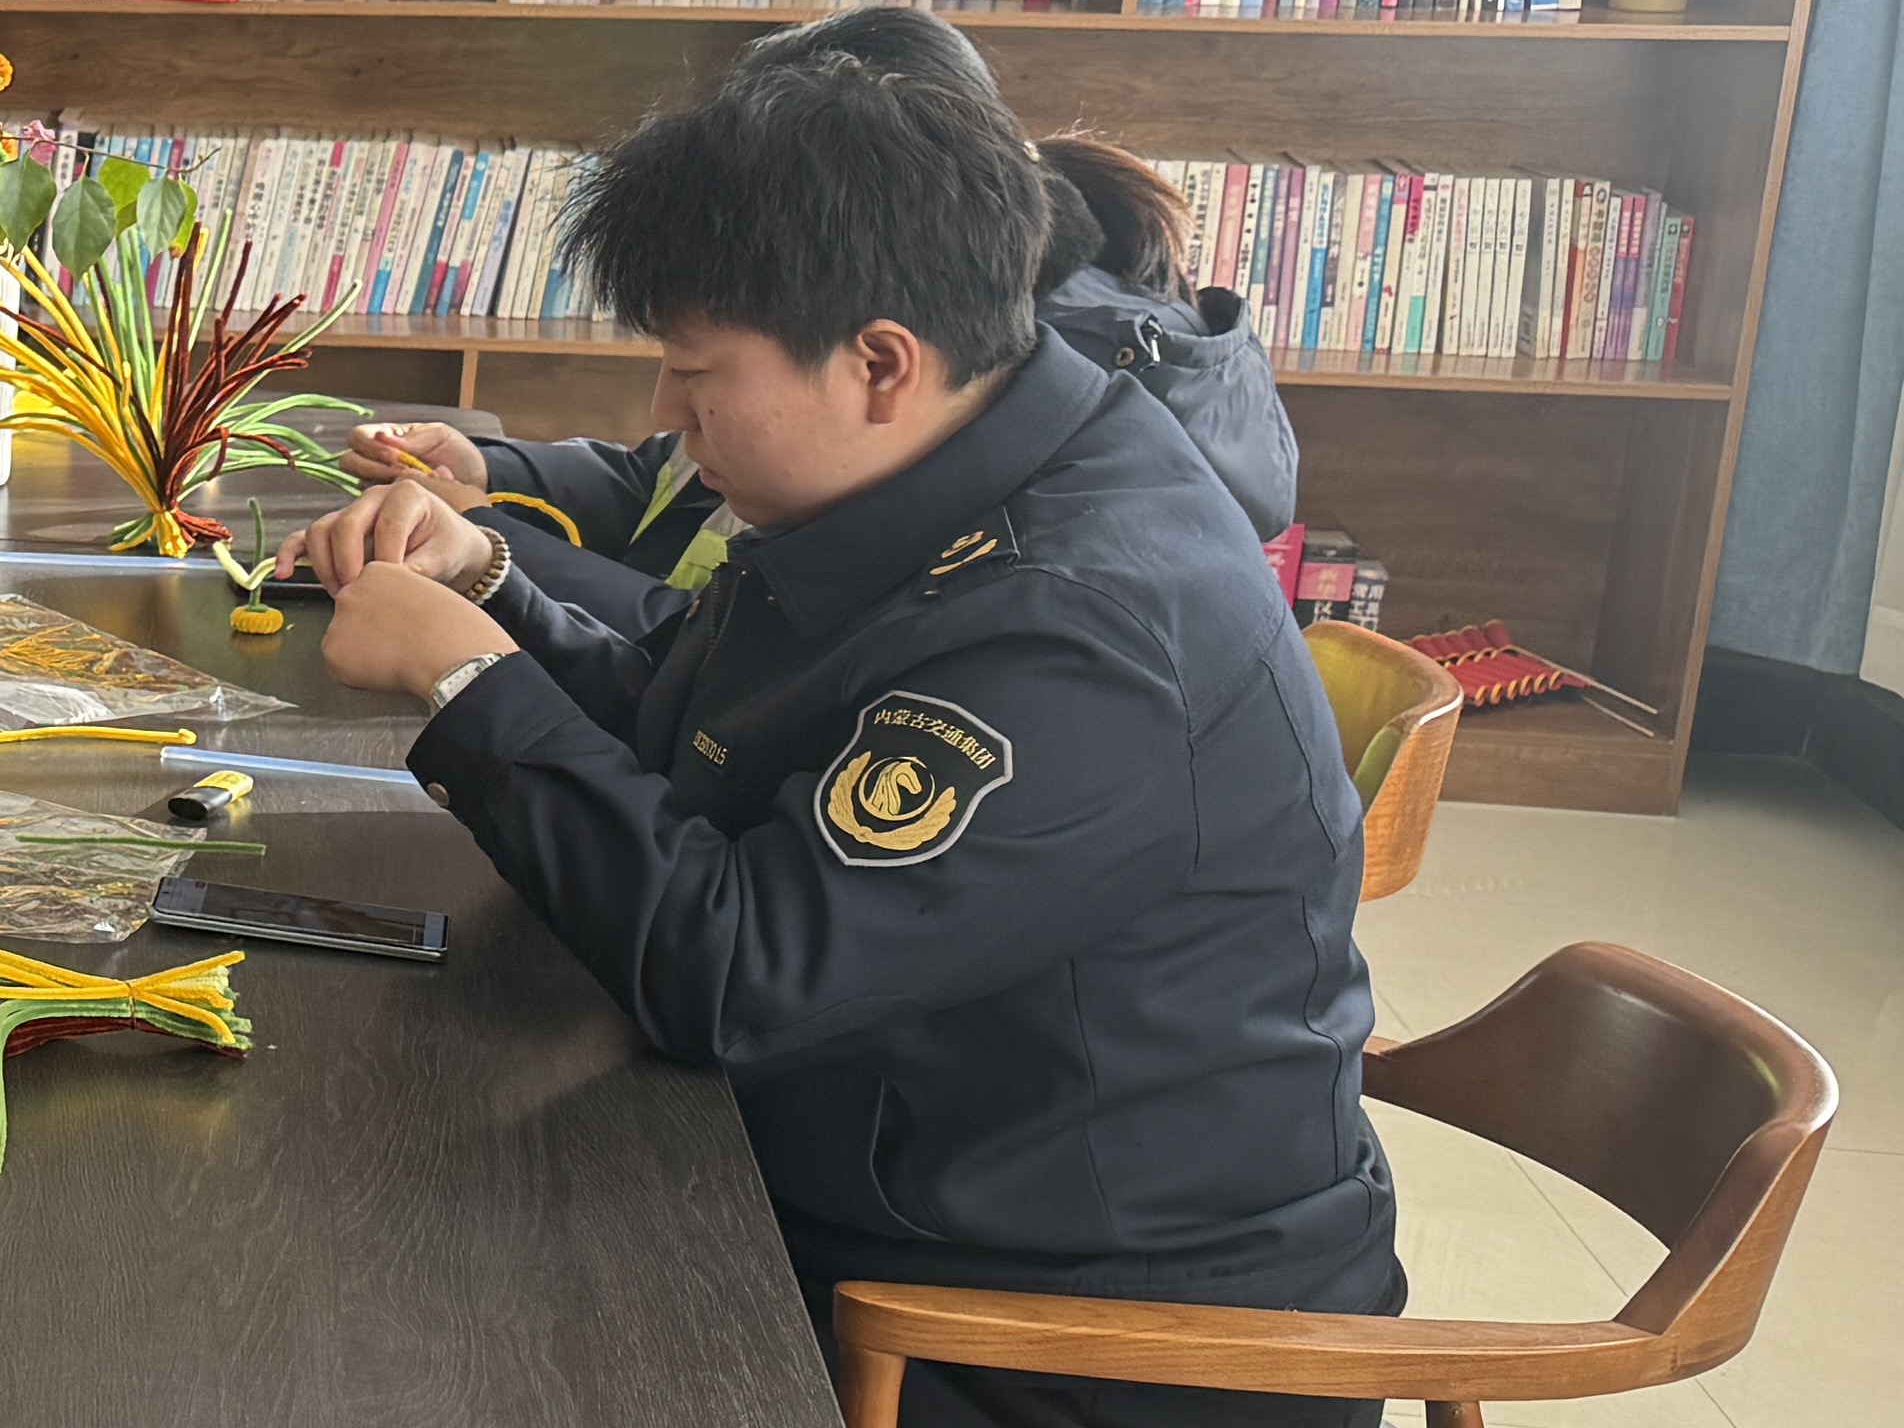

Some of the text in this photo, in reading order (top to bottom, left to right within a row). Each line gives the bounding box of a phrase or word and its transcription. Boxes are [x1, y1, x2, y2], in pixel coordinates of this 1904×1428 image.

[873, 707, 997, 771] 内蒙古交通集团
